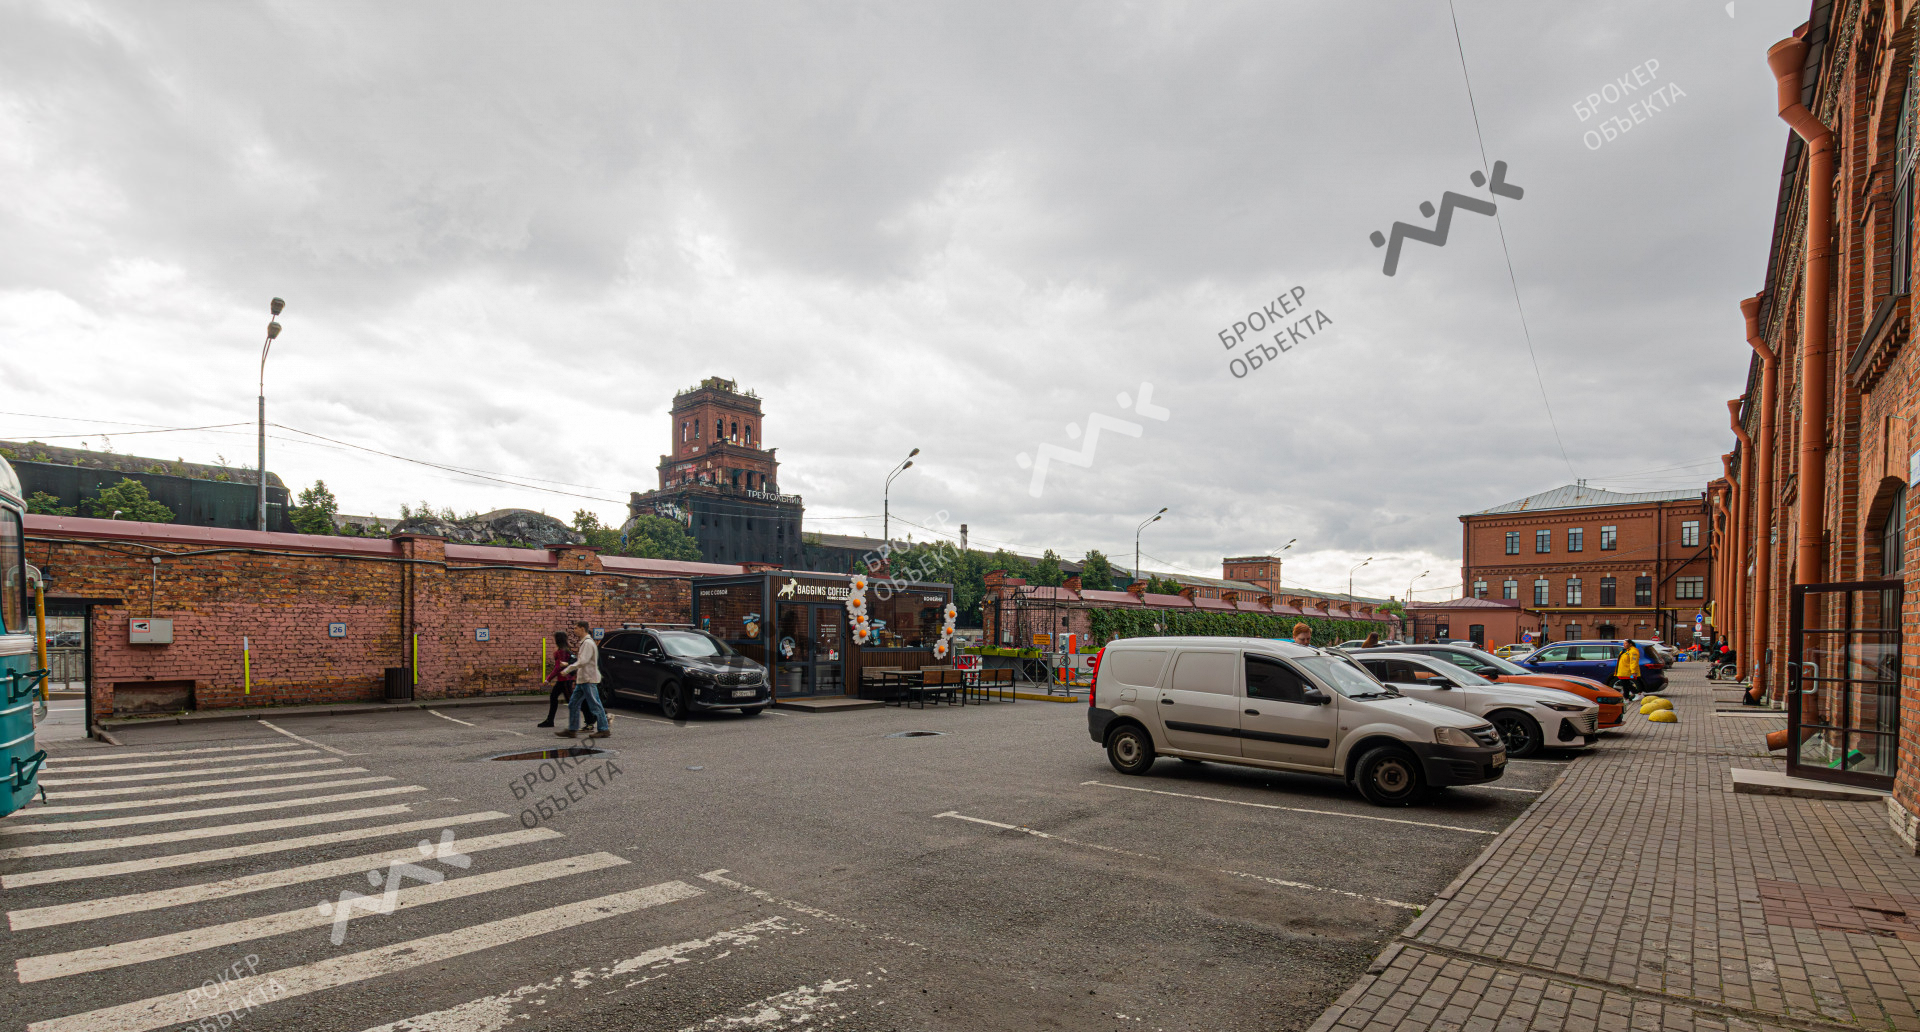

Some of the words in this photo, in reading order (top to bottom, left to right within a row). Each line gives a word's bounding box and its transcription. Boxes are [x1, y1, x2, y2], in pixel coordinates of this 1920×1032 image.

[747, 489, 801, 505] ТРЕУГОЛЬНИК
[797, 584, 827, 596] BAGGINS
[827, 586, 850, 597] COFFEE
